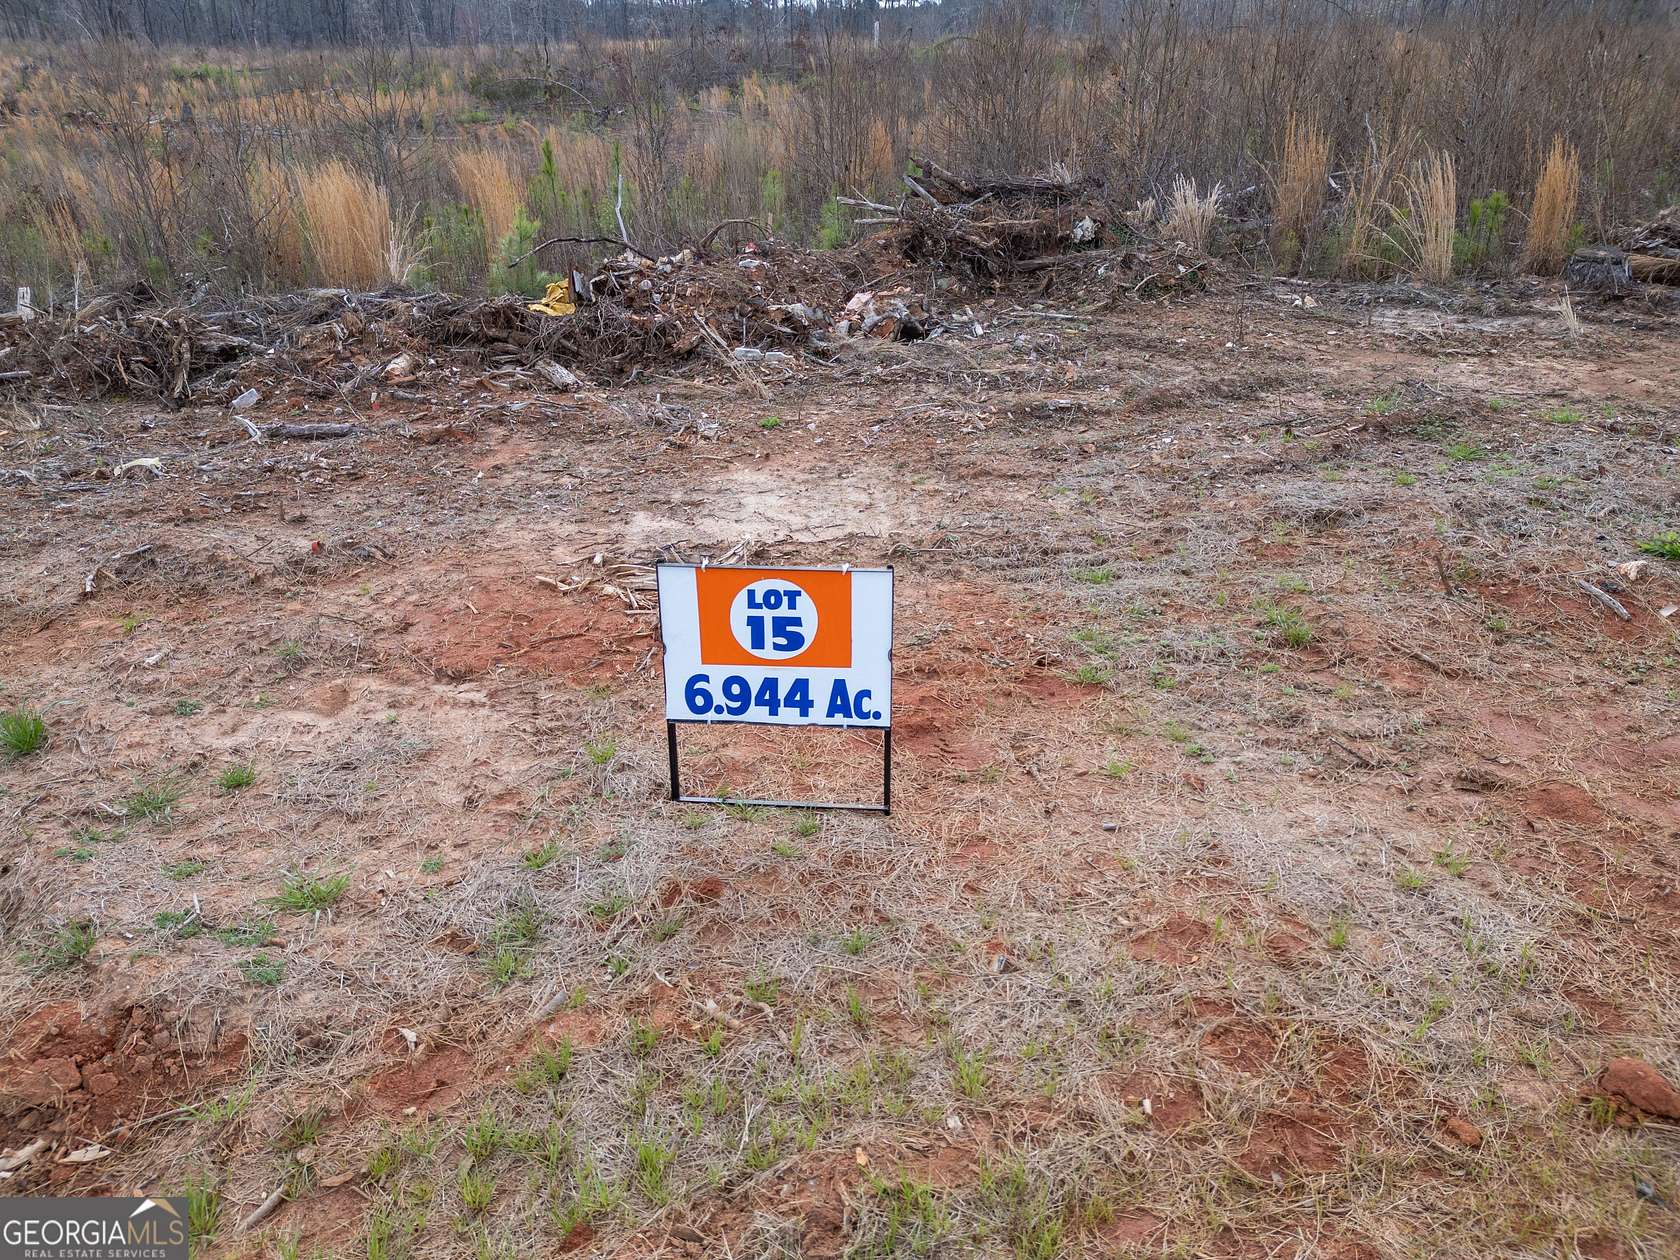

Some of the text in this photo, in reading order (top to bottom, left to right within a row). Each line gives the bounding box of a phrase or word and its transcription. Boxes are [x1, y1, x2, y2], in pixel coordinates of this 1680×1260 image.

[747, 588, 802, 610] LOT
[746, 616, 805, 652] 15
[684, 673, 882, 720] 6.944 Ac.
